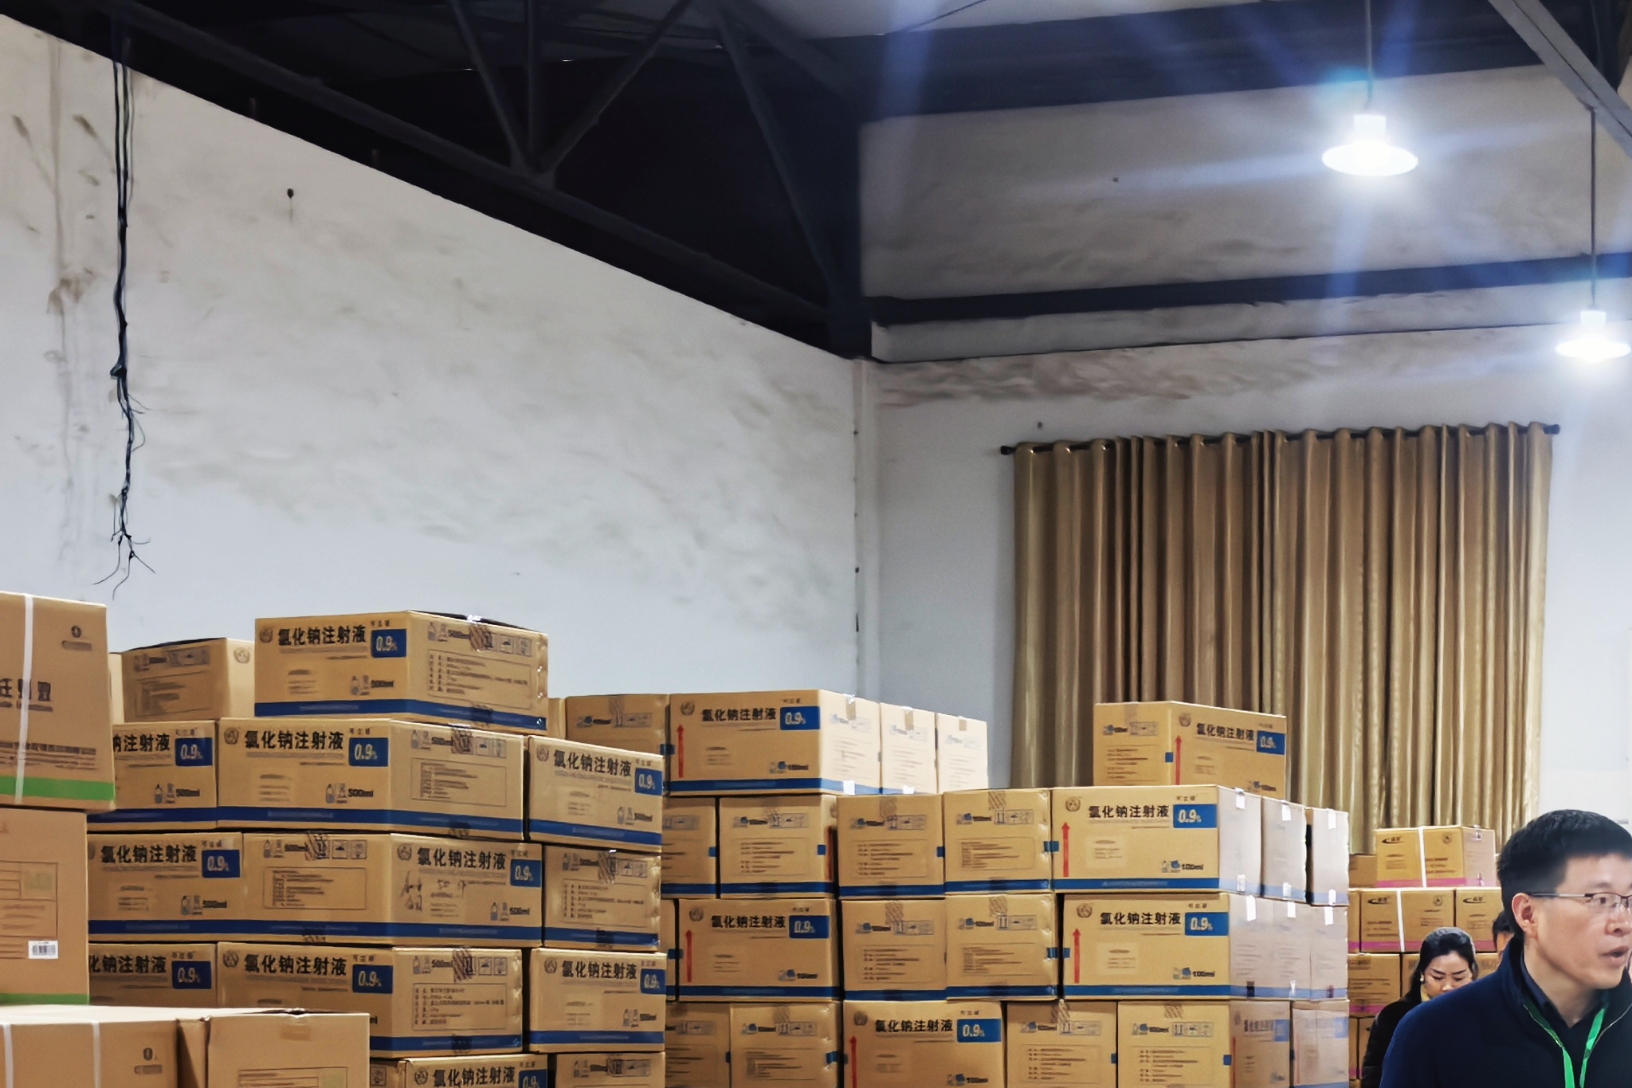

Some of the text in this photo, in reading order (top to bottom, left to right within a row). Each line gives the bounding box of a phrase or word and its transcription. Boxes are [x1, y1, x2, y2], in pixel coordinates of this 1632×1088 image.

[278, 625, 366, 646] 氯化钠注射液
[702, 708, 776, 721] 氯化钠注射液
[245, 730, 344, 750] 氯化钠注射液
[553, 751, 632, 779] 氯化钠注射液
[1088, 805, 1170, 819] 氯化钠注射液
[101, 845, 197, 863] 氯化钠注射液
[417, 847, 506, 869] 氯化钠注射液
[711, 916, 786, 929] 氯化钠注射液
[1100, 912, 1181, 926] 氯化钠注射液
[244, 953, 347, 977] 氯化钠注射液
[562, 960, 637, 980] 氯化钠注射液
